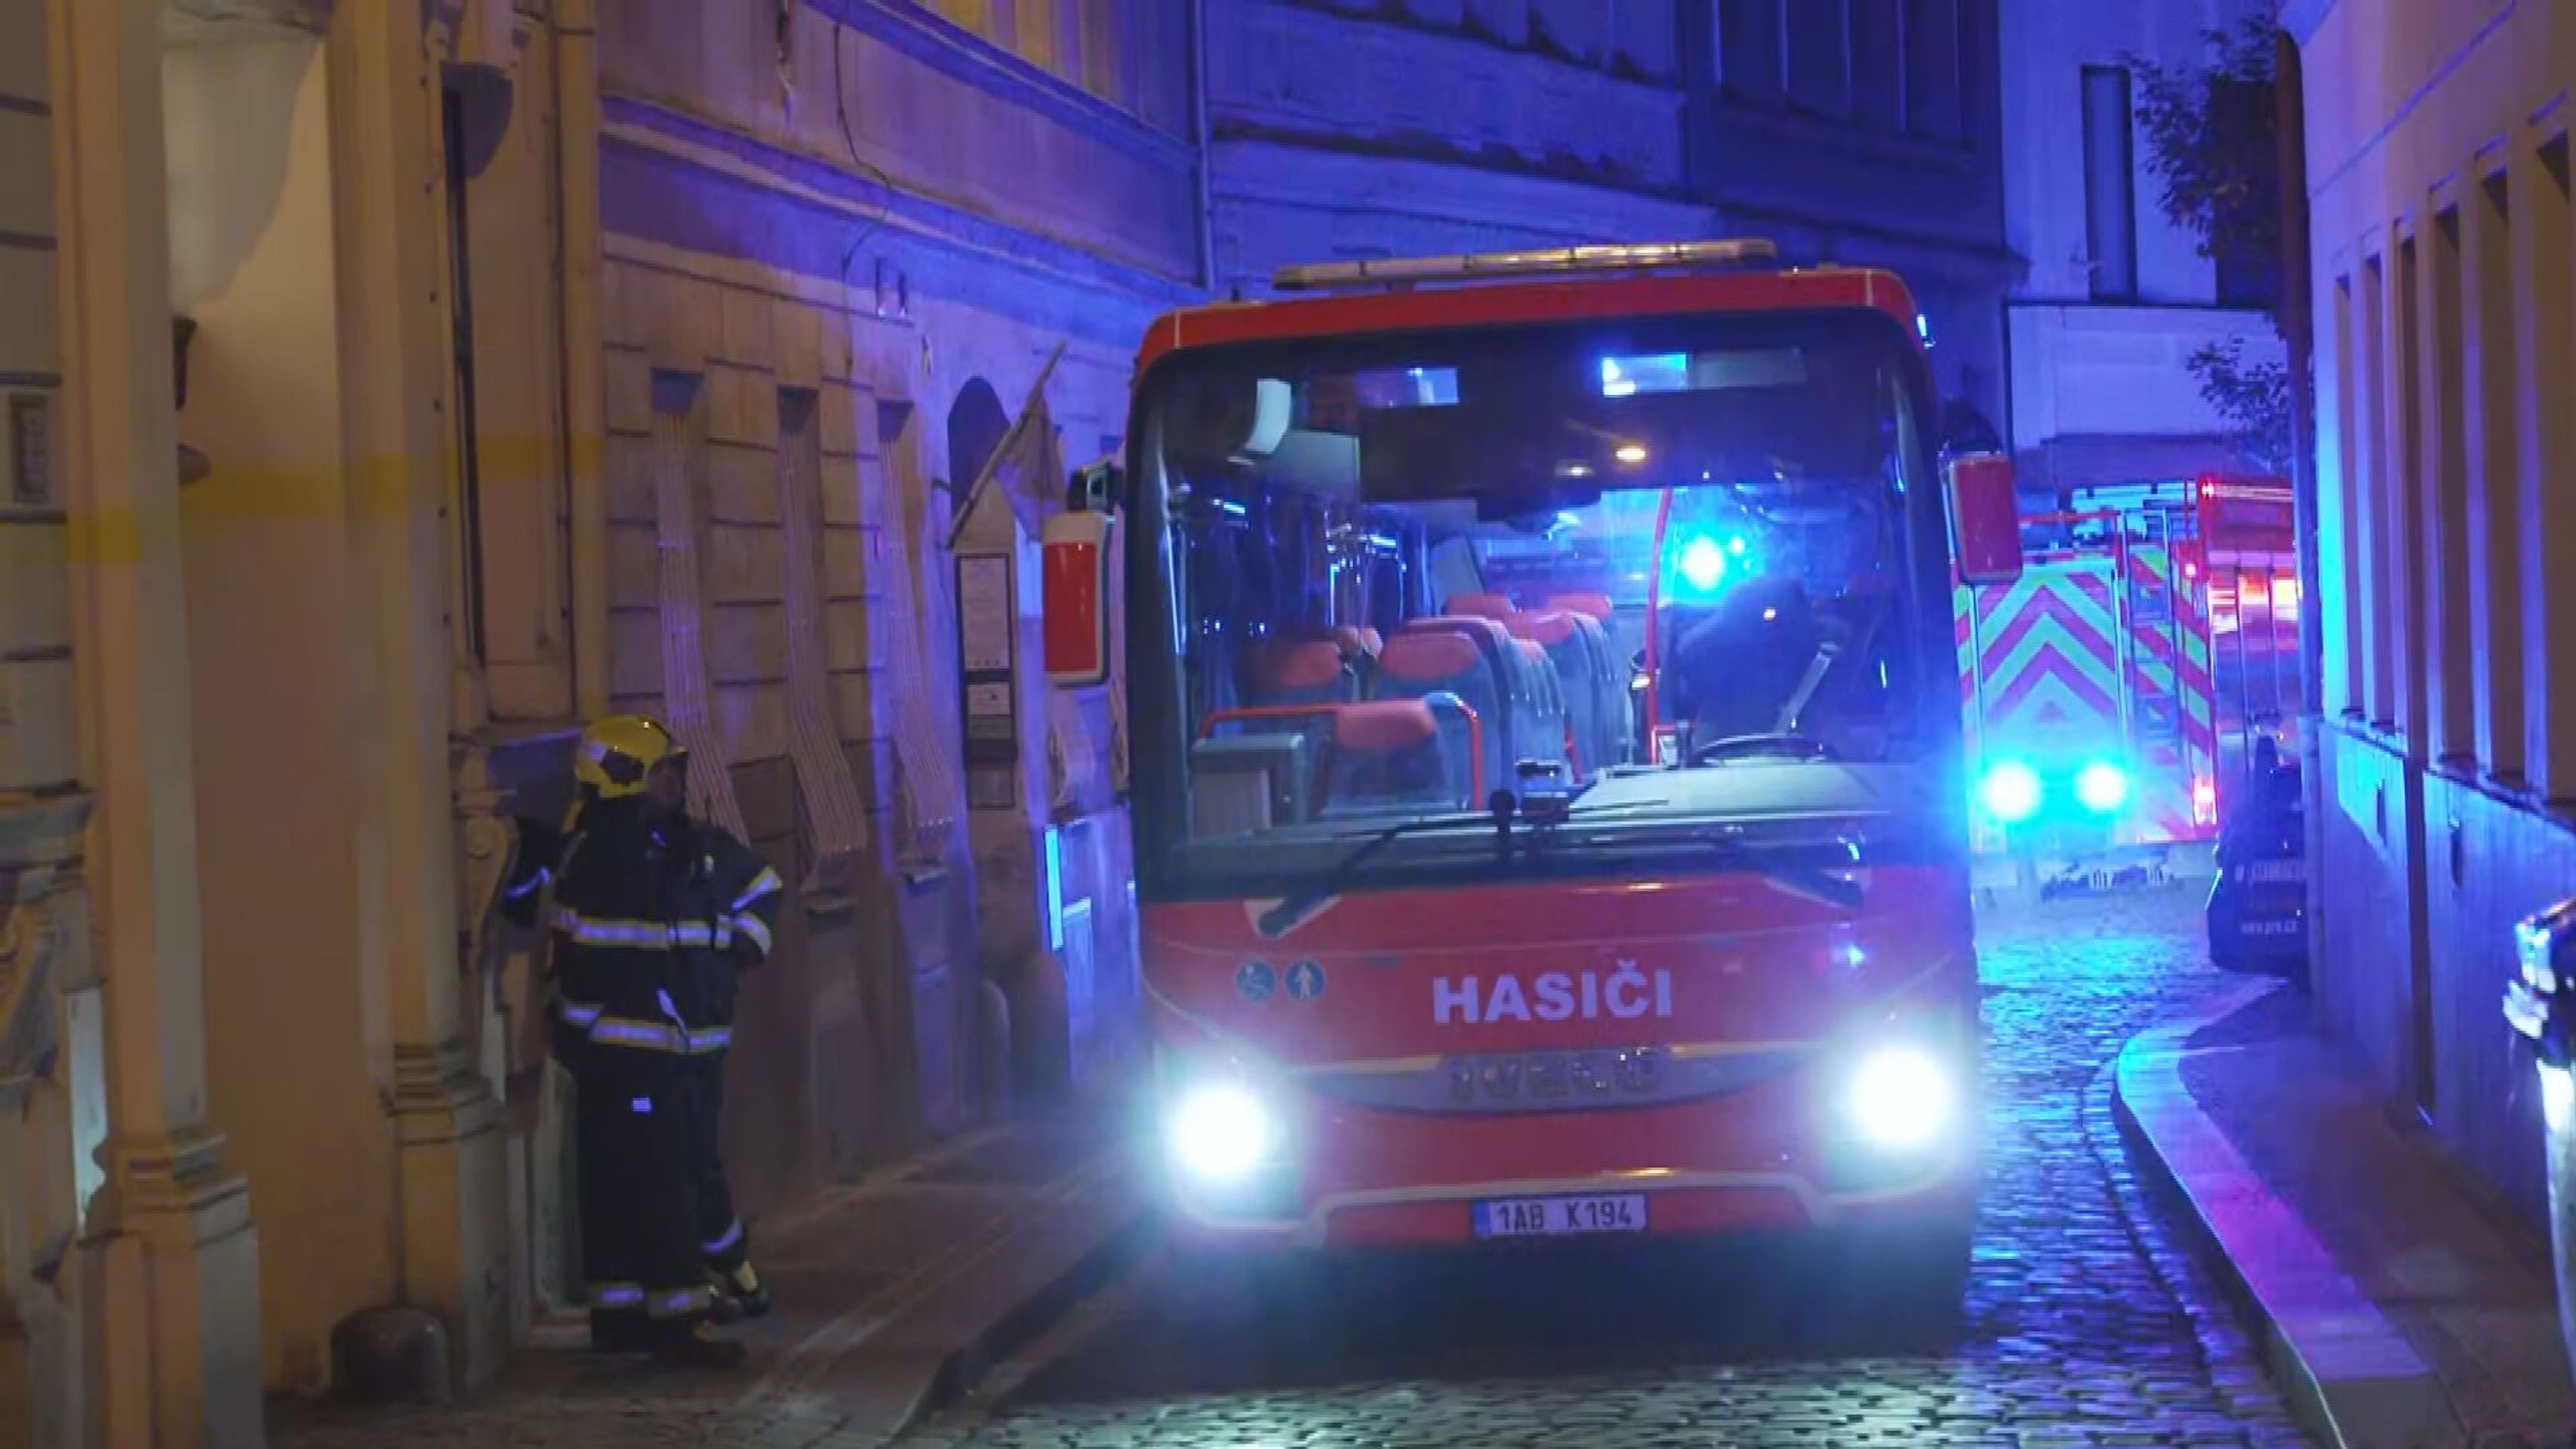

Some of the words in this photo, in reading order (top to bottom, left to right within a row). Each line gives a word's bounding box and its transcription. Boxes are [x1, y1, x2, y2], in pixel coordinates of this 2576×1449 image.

[1434, 959, 1673, 1023] HASIČI
[1496, 1204, 1546, 1232] 1AB
[1565, 1200, 1633, 1228] K194
